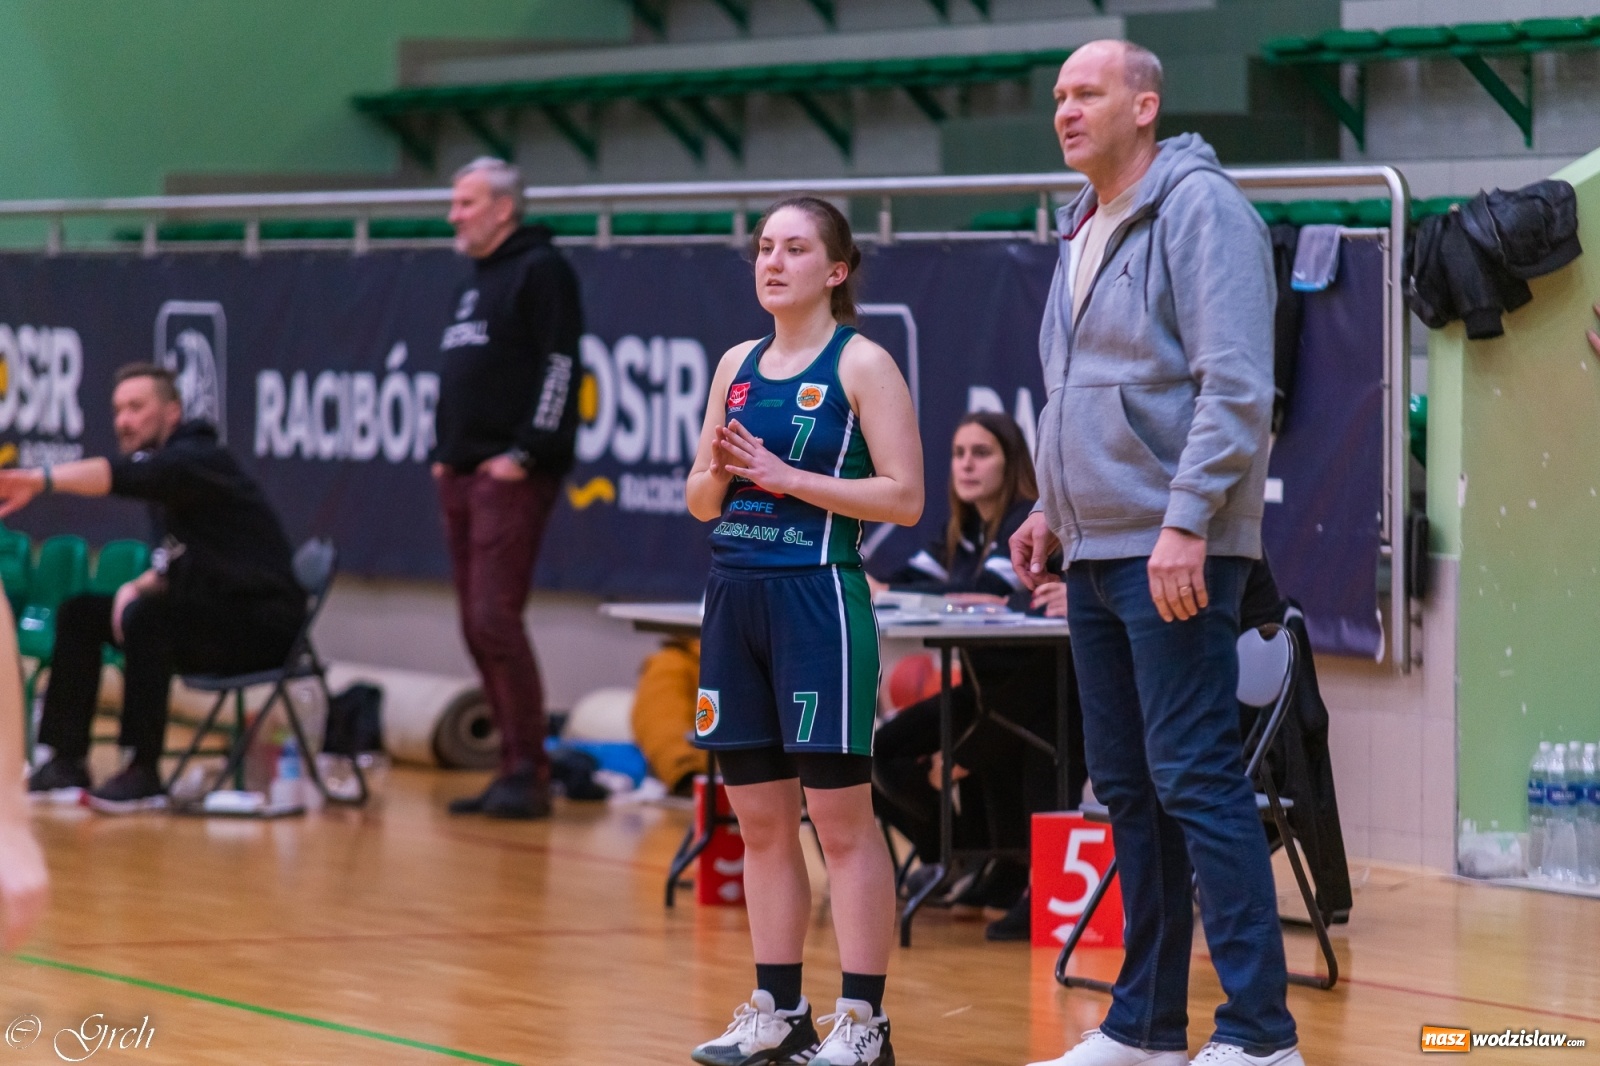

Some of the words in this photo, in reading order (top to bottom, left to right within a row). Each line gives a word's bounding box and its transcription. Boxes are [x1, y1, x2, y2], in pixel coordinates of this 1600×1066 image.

[788, 415, 816, 461] 7
[782, 527, 814, 547] ŚL.
[793, 691, 818, 742] 7
[1047, 828, 1106, 917] 5
